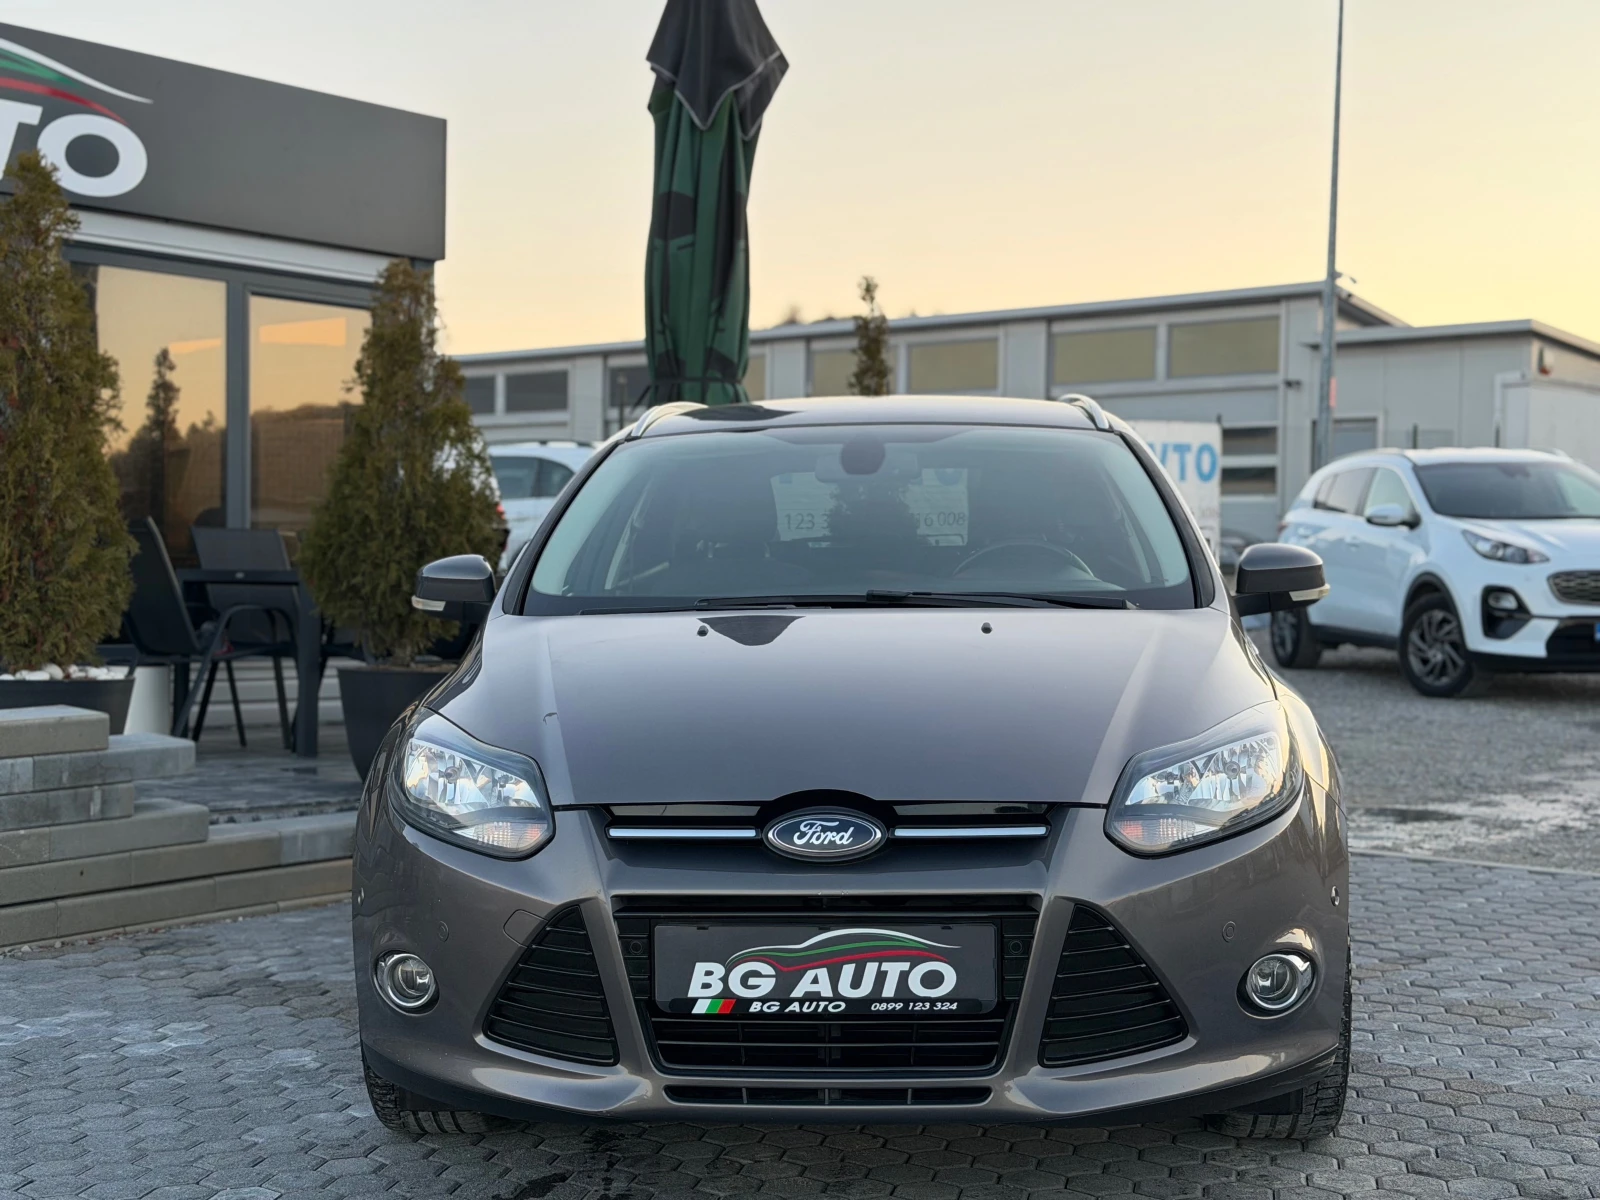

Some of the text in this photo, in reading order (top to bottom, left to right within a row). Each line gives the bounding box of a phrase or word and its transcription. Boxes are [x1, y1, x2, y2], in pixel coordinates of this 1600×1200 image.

[784, 512, 816, 531] 123
[793, 820, 855, 845] Ford
[687, 961, 957, 998] BG AUTO
[748, 1001, 958, 1013] BG AUTO 0899 123 324
